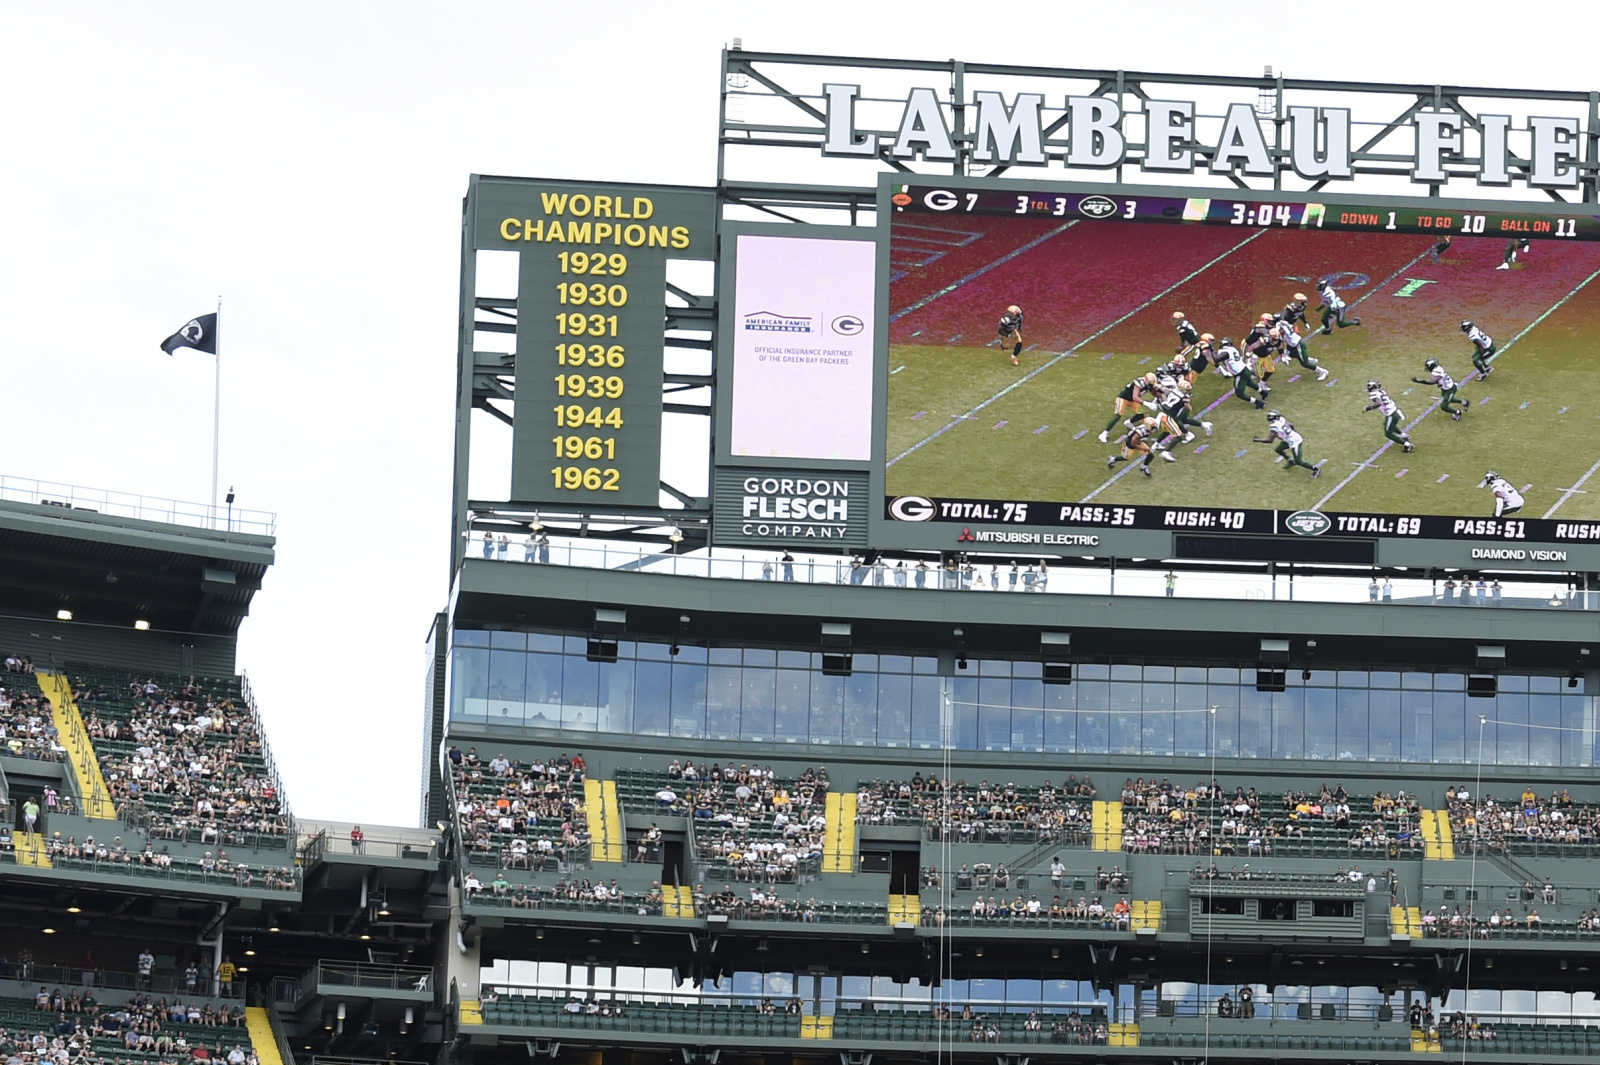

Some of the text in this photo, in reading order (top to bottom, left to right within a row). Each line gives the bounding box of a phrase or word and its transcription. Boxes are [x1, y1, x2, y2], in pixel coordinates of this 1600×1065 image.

[821, 82, 1352, 180] LAMBEAU
[541, 192, 654, 220] WORLD
[965, 194, 978, 211] 7
[1015, 196, 1028, 214] 3
[1053, 198, 1066, 216] 3
[1124, 201, 1137, 219] 3
[1230, 204, 1292, 227] 3:04
[1341, 212, 1397, 230] DOWN 1
[1417, 215, 1486, 234] TO GO 10
[500, 217, 690, 249] CHAMPIONS
[1501, 218, 1576, 237] BALL ON 11
[558, 251, 628, 276] 1929
[556, 282, 628, 307] 1930
[556, 312, 618, 337] 1931
[746, 318, 782, 326] AMERICAN
[555, 344, 625, 368] 1936
[754, 346, 782, 354] OFFICIAL
[784, 348, 821, 356] INSURANCE
[806, 356, 818, 364] BAY
[554, 374, 624, 398] 1939
[554, 405, 623, 429] 1944
[553, 436, 615, 460] 1961
[552, 466, 620, 491] 1962
[744, 477, 848, 496] GORDON
[742, 496, 848, 520] FLESCH
[742, 524, 847, 538] COMPANY
[976, 531, 1099, 546] MITSUBISHI ELECTRIC
[1472, 548, 1567, 562] DIAMOND VISION
